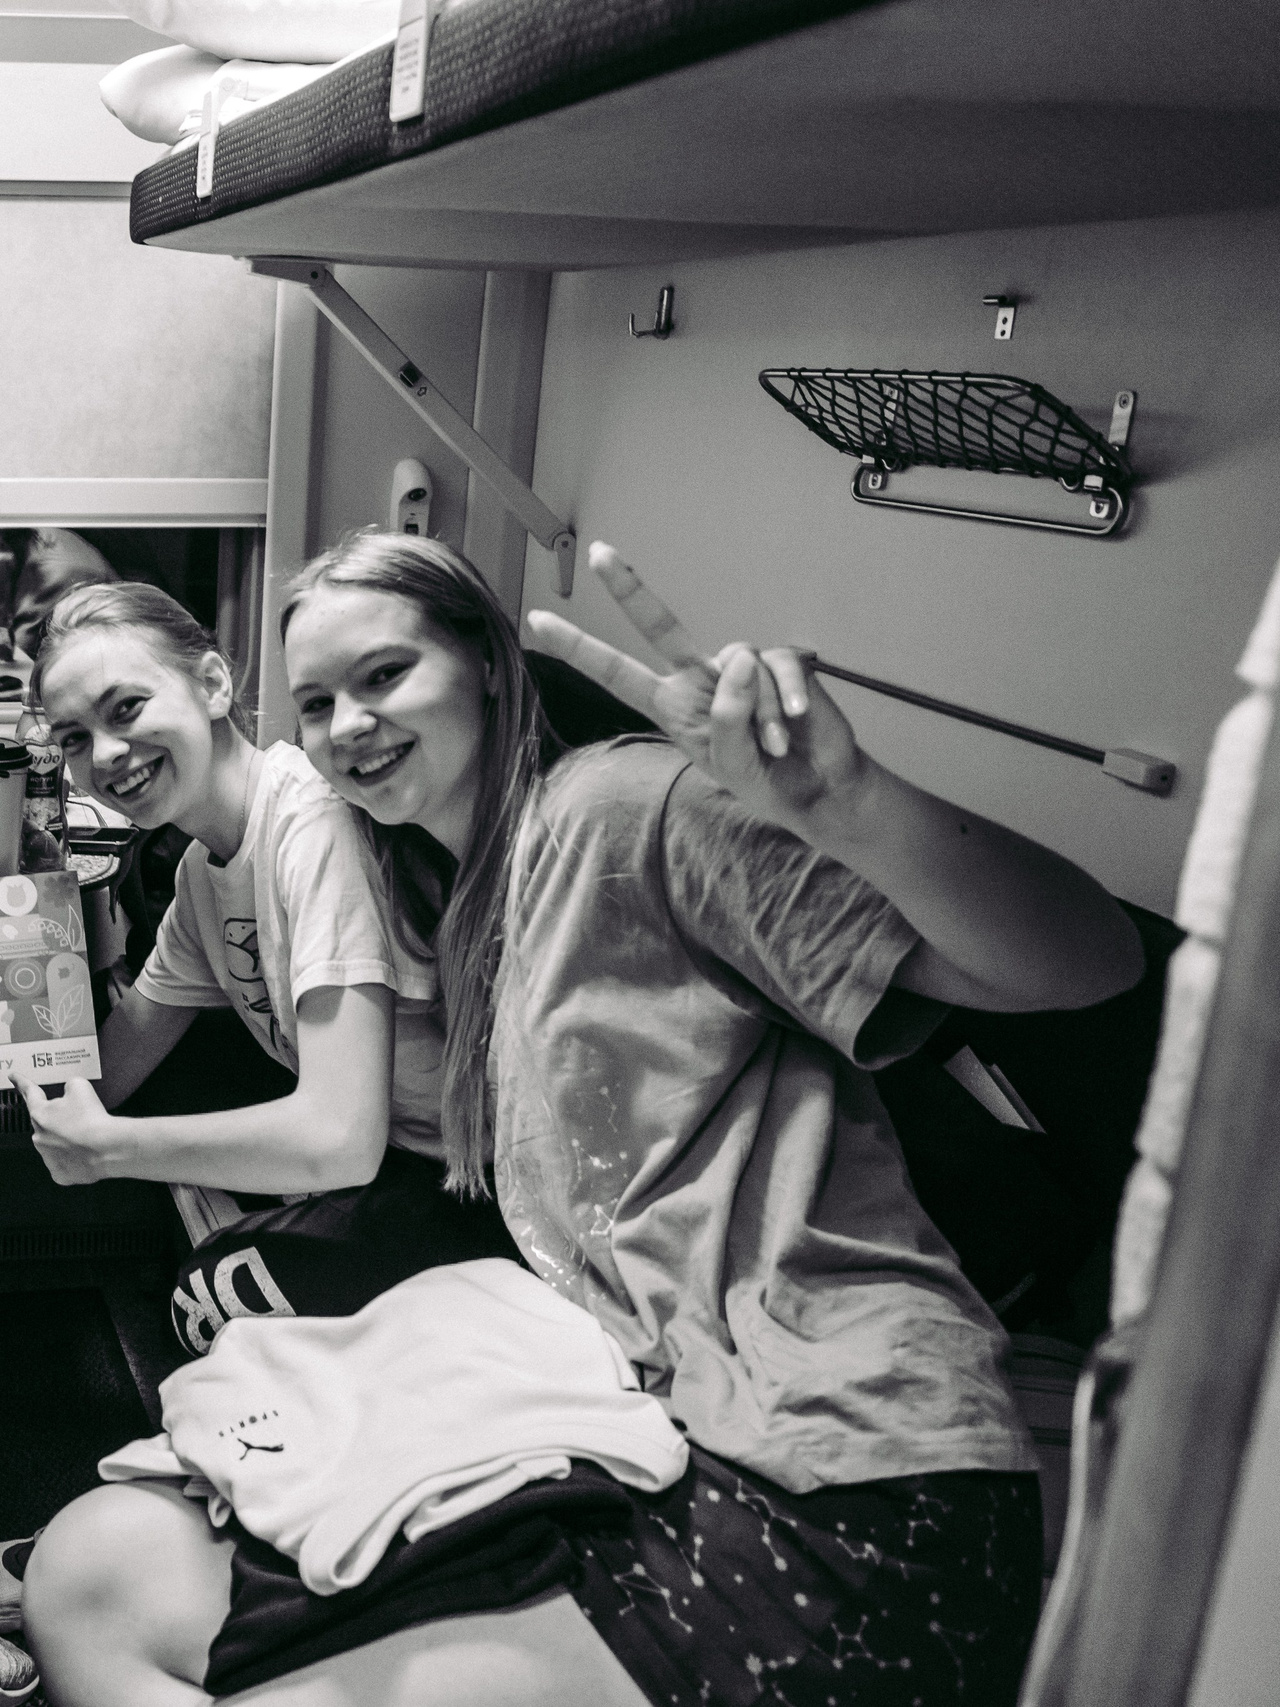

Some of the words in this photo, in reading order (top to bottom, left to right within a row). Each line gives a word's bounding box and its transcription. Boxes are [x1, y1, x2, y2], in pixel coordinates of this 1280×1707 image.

[33, 752, 60, 768] удо
[31, 1053, 47, 1068] 15
[172, 1246, 297, 1358] DR
[218, 1409, 280, 1438] SPORTS
